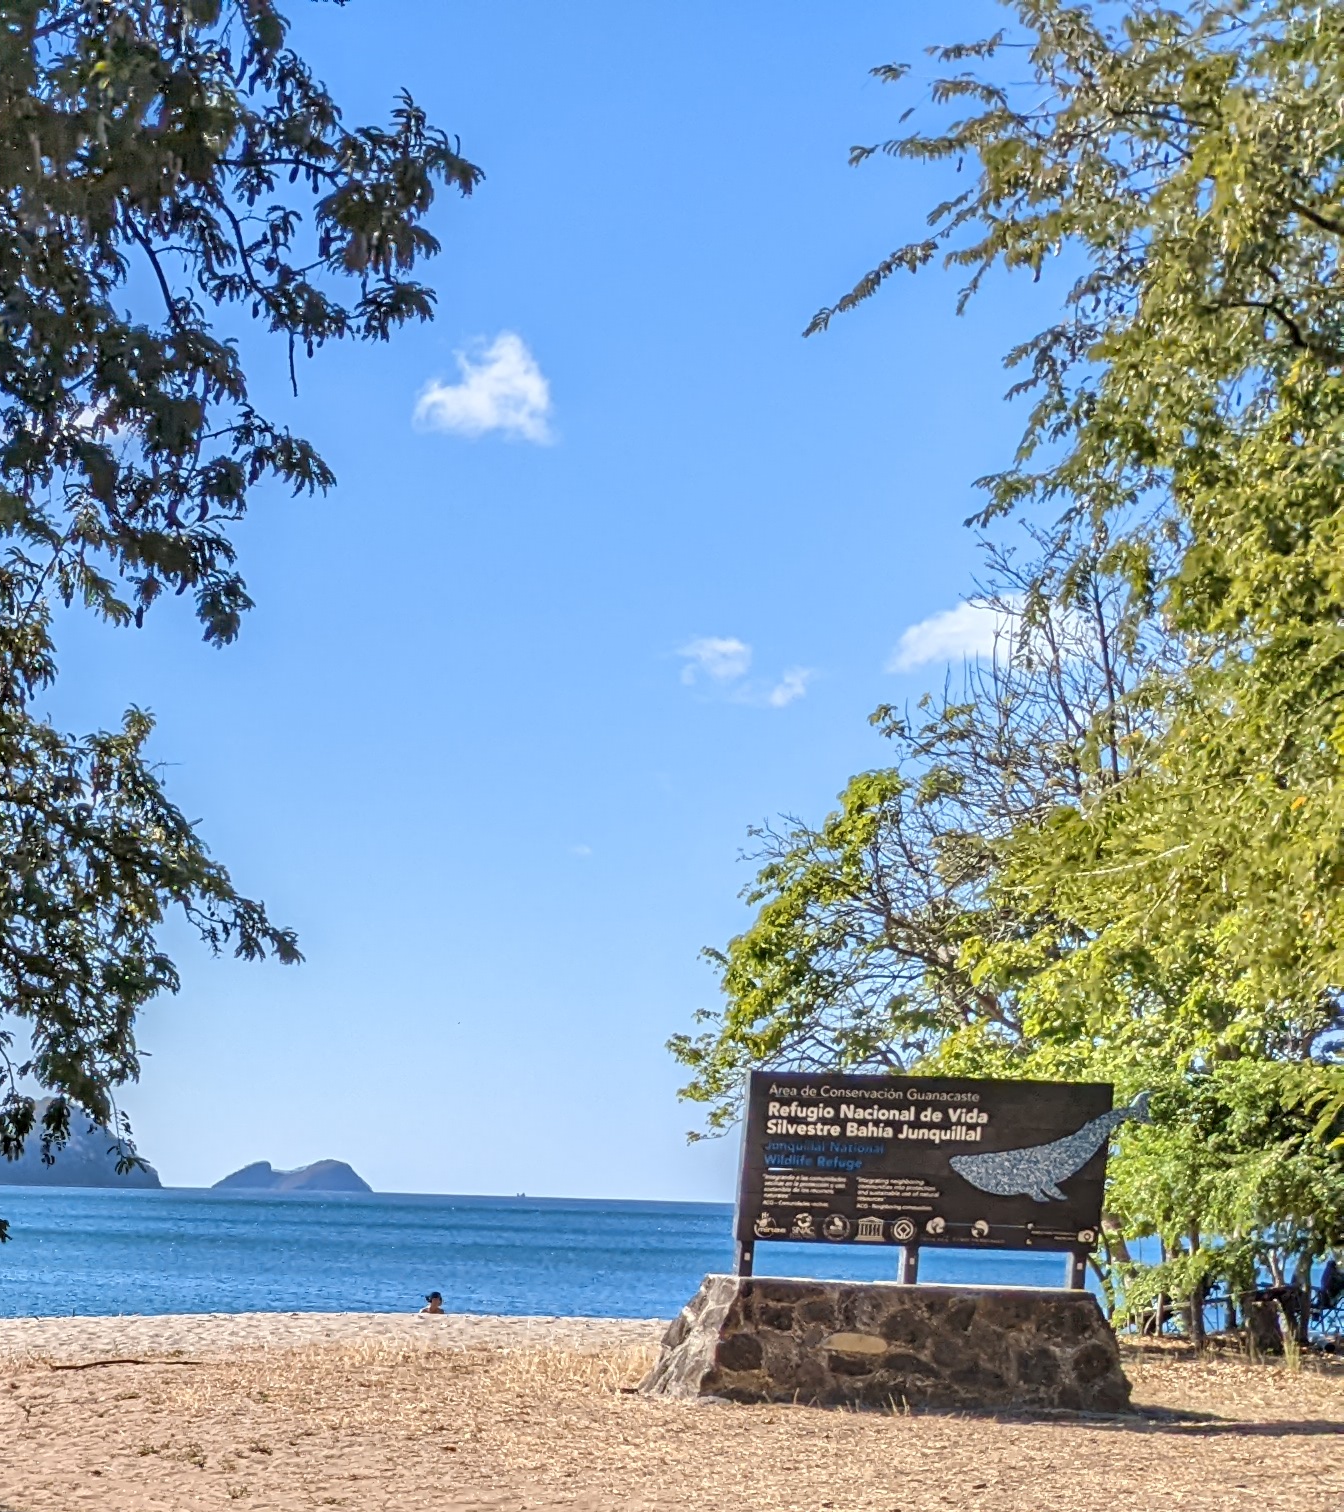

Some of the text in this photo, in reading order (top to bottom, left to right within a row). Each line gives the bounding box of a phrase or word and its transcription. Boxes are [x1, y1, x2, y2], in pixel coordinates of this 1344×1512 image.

[769, 1082, 980, 1102] Área de Conservación Guanacaste
[768, 1101, 989, 1124] Refugio Nacional de Vida
[766, 1119, 841, 1136] Silvestre
[897, 1123, 982, 1144] Junquillal
[763, 1154, 863, 1170] Wildlife Refuge
